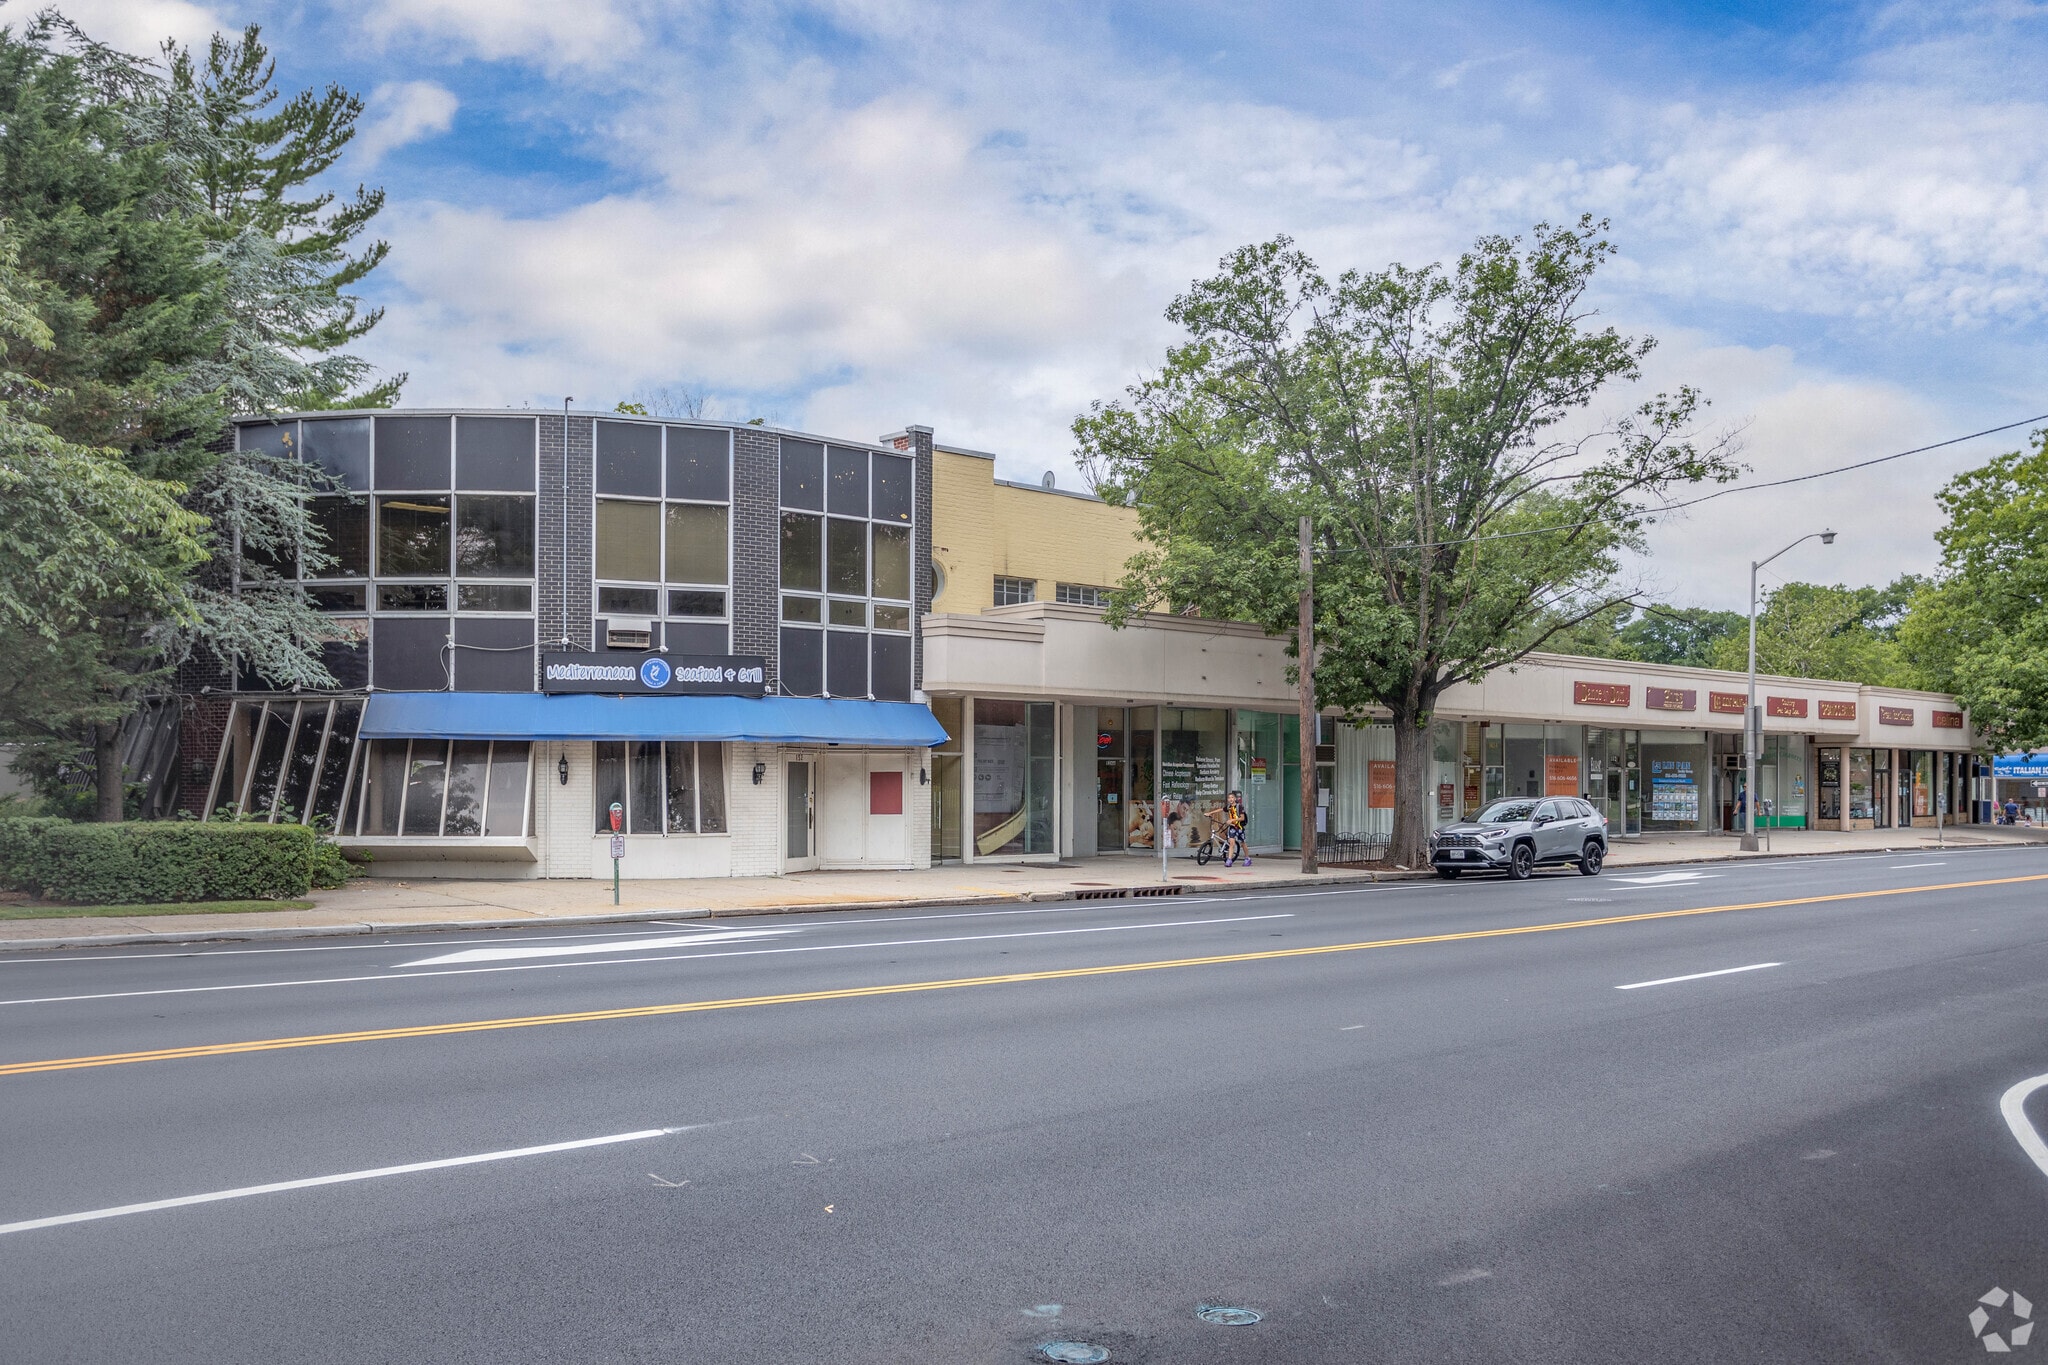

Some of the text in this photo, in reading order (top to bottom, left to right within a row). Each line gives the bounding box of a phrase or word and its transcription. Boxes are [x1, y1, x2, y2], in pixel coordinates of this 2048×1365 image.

[547, 663, 636, 681] Mediterranean
[675, 666, 722, 683] Seafood
[737, 667, 763, 683] Grill
[2013, 766, 2040, 774] ITALIAN
